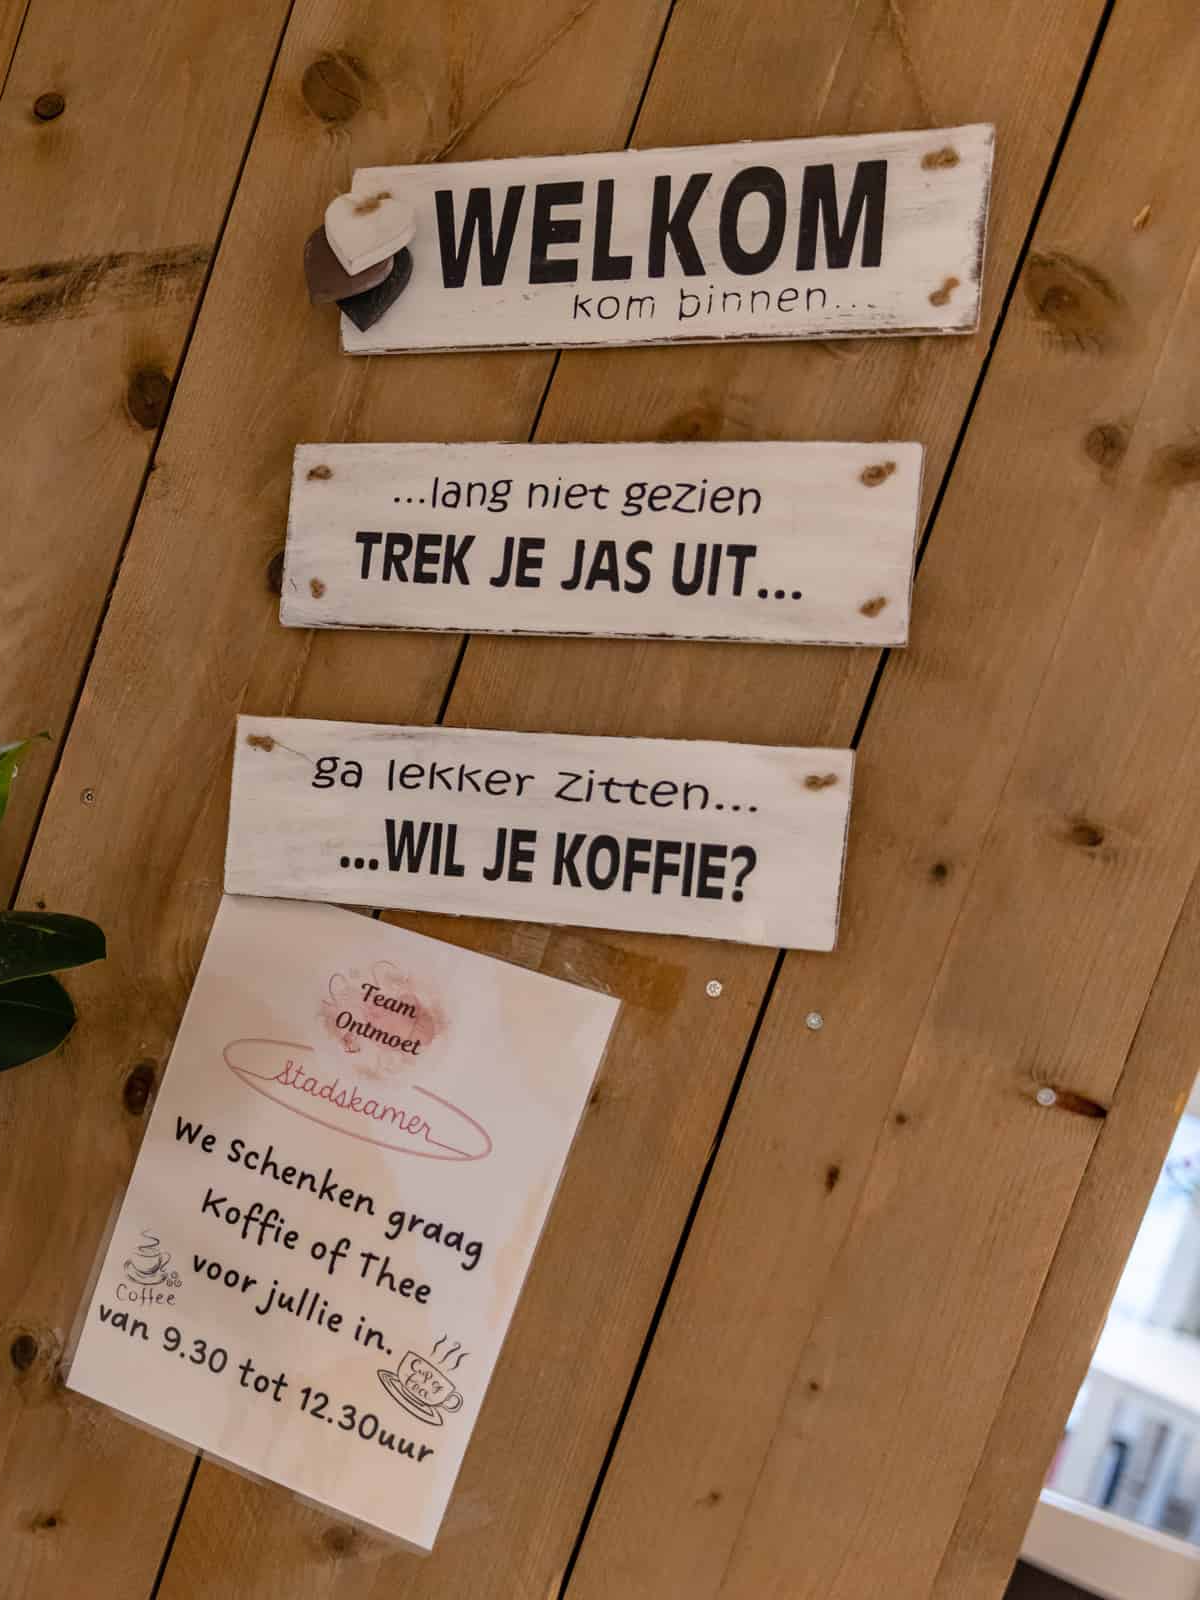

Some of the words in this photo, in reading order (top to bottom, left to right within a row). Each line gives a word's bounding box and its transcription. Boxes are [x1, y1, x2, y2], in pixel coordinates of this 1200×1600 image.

[434, 159, 887, 288] WELKOM
[572, 291, 656, 321] kom
[393, 477, 512, 513] ...lang
[527, 478, 610, 510] niet
[621, 478, 762, 515] gezien
[355, 531, 476, 585] TREK
[489, 536, 546, 589] JE
[561, 539, 653, 593] JAS
[671, 542, 803, 600] UIT...
[310, 754, 364, 790] ga
[387, 758, 535, 797] lekker
[339, 817, 465, 877] ...WIL
[482, 826, 536, 882] JE
[552, 831, 757, 902] KOFFIE?
[335, 1011, 422, 1055] Ontmoet
[361, 983, 418, 1019] Team
[175, 1116, 216, 1152] We
[385, 1211, 483, 1270] graag
[201, 1188, 299, 1249] Koffie
[310, 1238, 351, 1275] of
[360, 1251, 432, 1304] Thee
[116, 1283, 176, 1305] Coffee
[193, 1254, 257, 1293] voor
[255, 1280, 344, 1333] jullie
[353, 1316, 393, 1355] in.
[99, 1303, 150, 1341] van
[162, 1326, 228, 1374] 9.30
[238, 1358, 288, 1402] tot
[300, 1387, 435, 1462] 12.30uur
